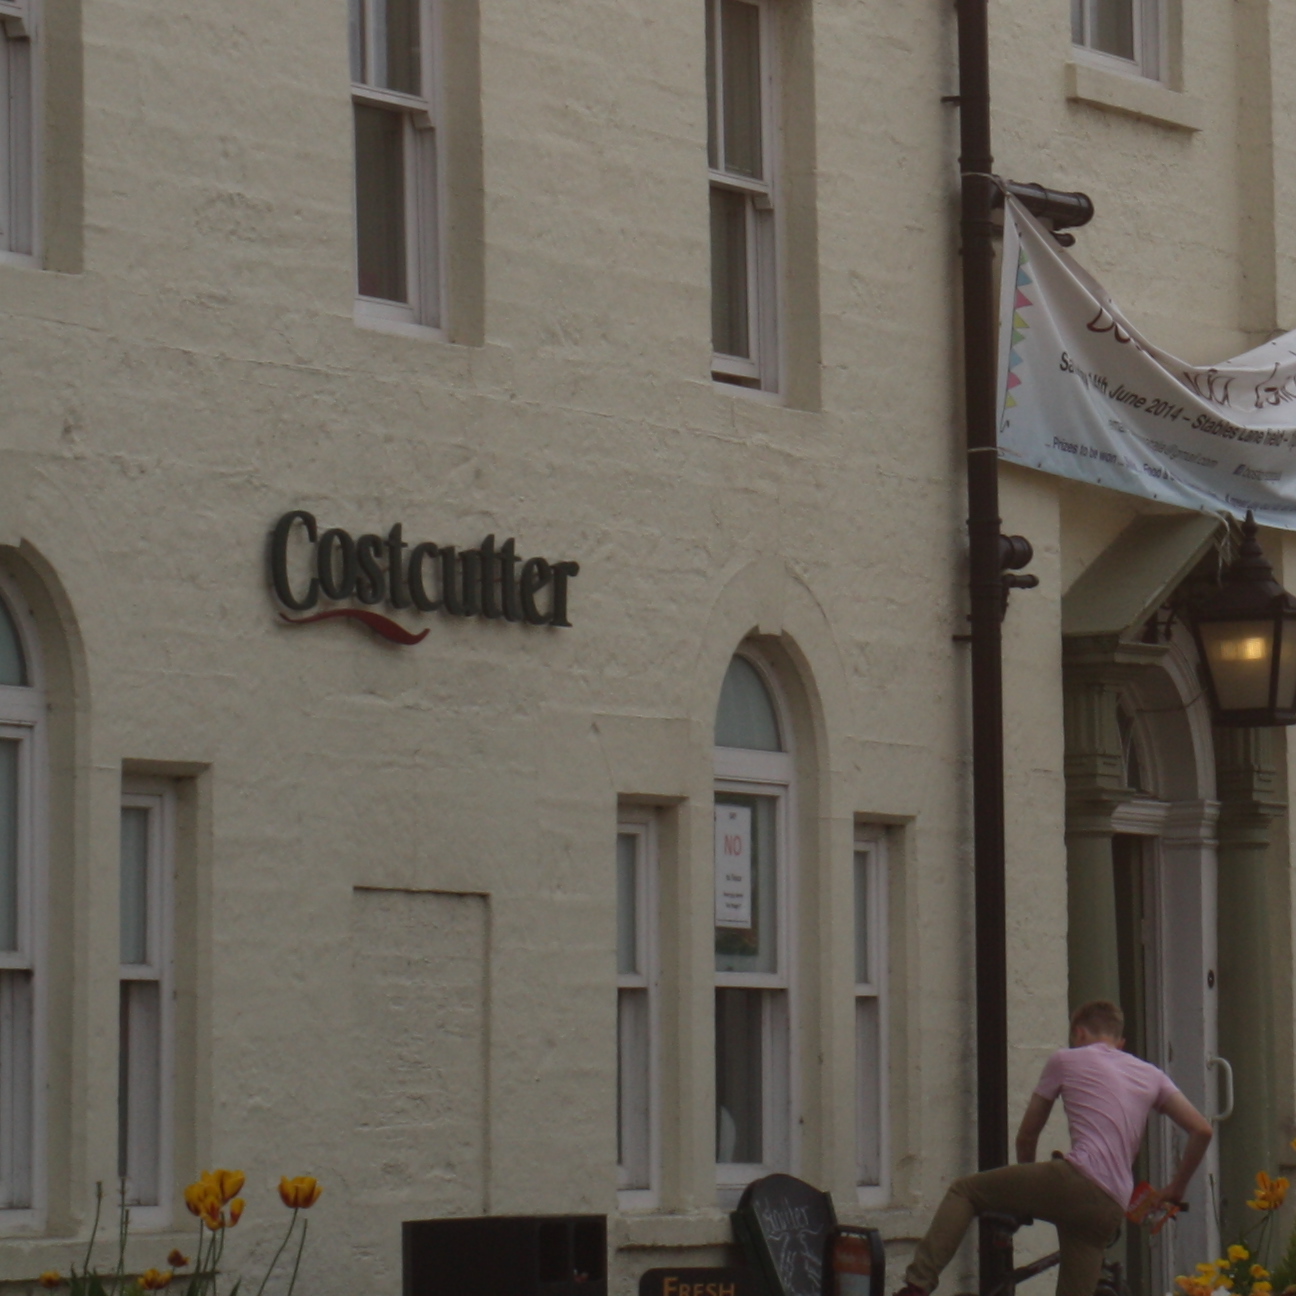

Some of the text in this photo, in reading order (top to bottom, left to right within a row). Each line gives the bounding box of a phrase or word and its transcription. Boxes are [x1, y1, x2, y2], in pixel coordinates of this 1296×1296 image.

[1109, 384, 1147, 408] June
[1145, 398, 1184, 421] 2014
[1191, 414, 1239, 439] Stables
[270, 510, 580, 628] Costcutter
[724, 835, 742, 856] NO
